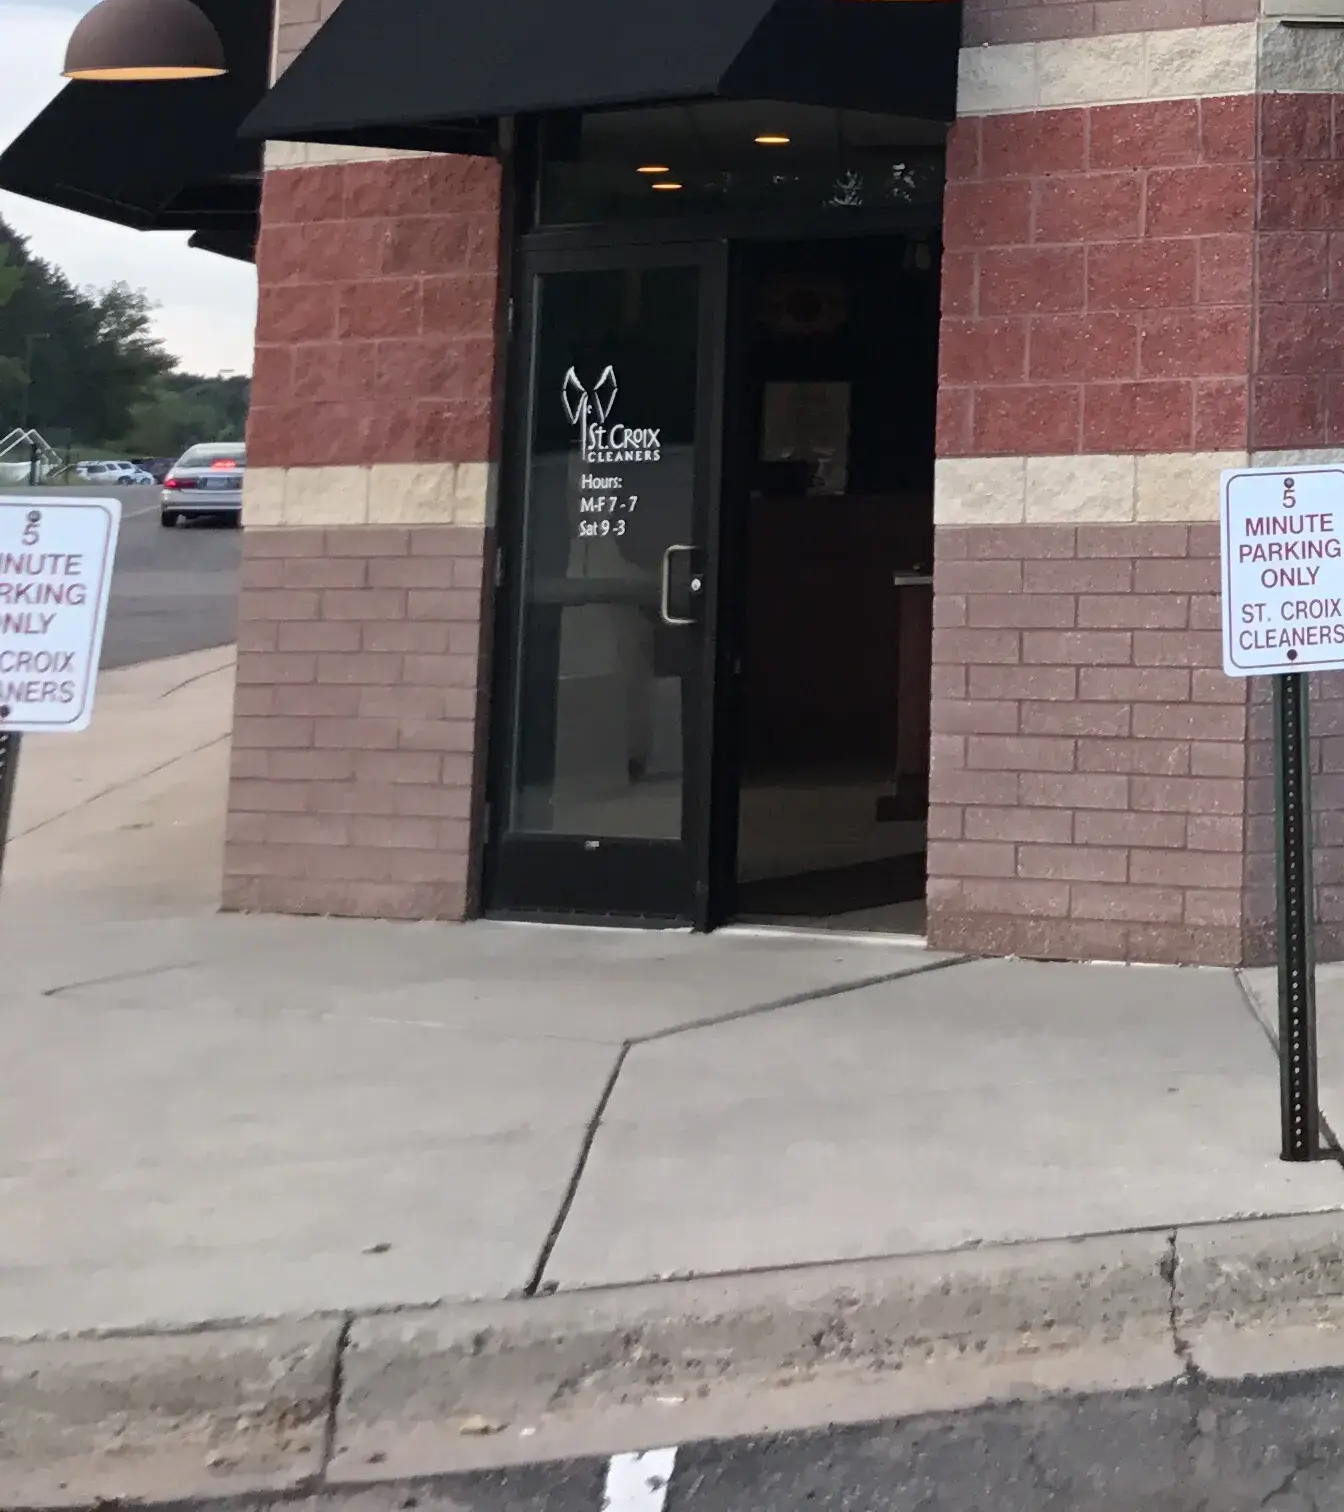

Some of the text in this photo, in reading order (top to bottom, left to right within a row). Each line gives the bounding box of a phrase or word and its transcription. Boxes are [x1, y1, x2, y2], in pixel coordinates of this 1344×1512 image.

[588, 422, 609, 450] St.
[587, 449, 661, 463] CLEANERS
[580, 473, 623, 490] Hours:
[579, 496, 606, 513] M-F
[608, 496, 618, 512] 7
[628, 495, 638, 512] 7
[1282, 488, 1297, 509] 5
[22, 522, 41, 546] 5
[578, 519, 598, 537] Sat
[600, 519, 610, 536] 9
[1245, 513, 1334, 536] MINUTE
[1239, 538, 1342, 564] PARKING
[0, 552, 84, 577] INUTE
[1261, 565, 1320, 589] ONLY
[0, 581, 87, 606] RKING
[0, 611, 57, 635] NLY
[1241, 598, 1342, 624] ST. CROIX
[0, 649, 76, 675] CROIX
[0, 679, 76, 704] NERS
